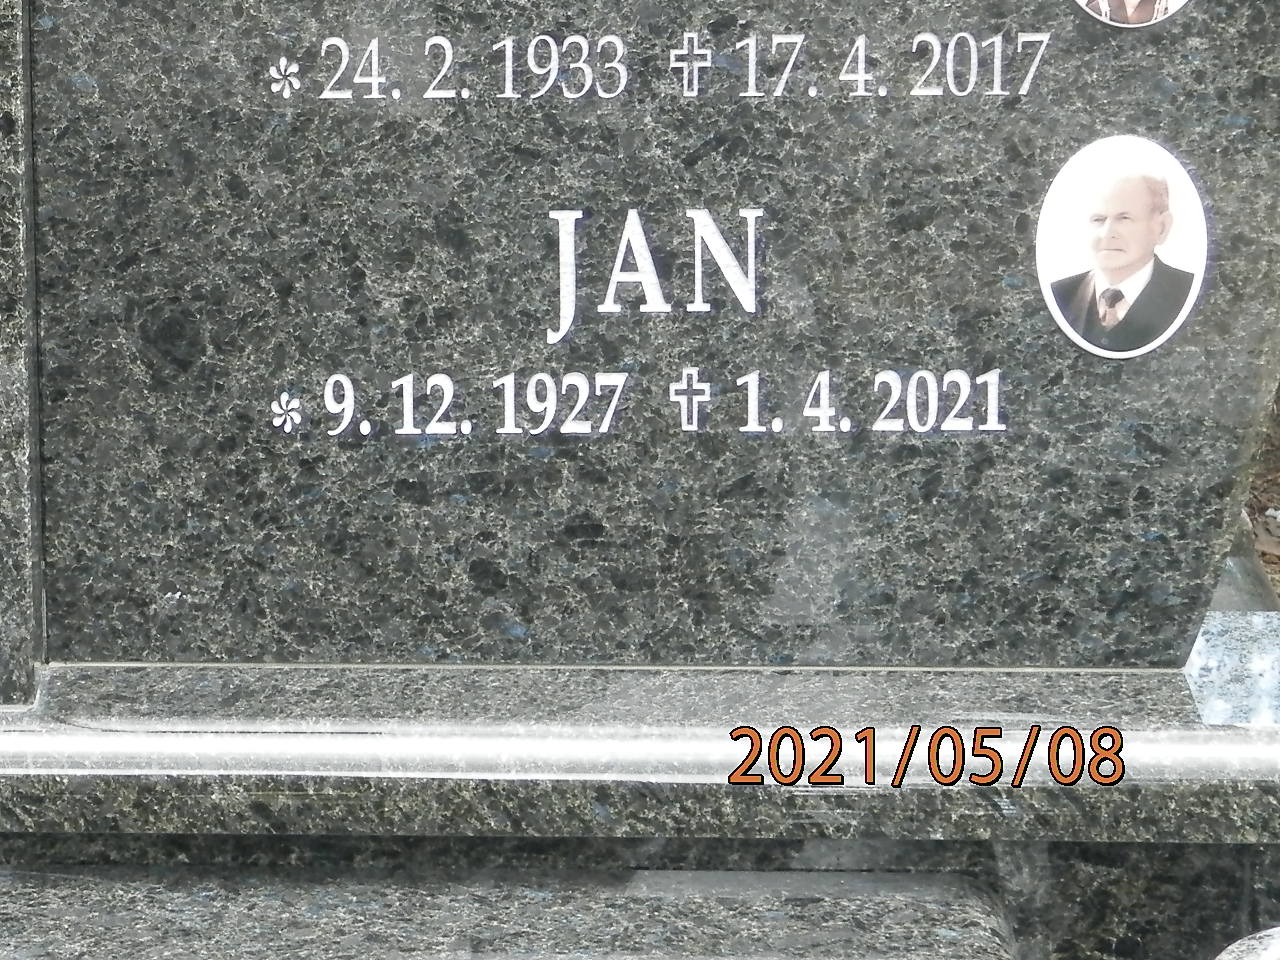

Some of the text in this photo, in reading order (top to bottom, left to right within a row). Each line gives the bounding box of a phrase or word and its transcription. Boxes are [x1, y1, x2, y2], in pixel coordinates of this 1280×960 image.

[318, 32, 1051, 100] 24. 2. 1933 17. 4. 2017
[547, 206, 769, 345] JAN
[322, 368, 1007, 438] 9. 12. 1927 1. 4. 2021
